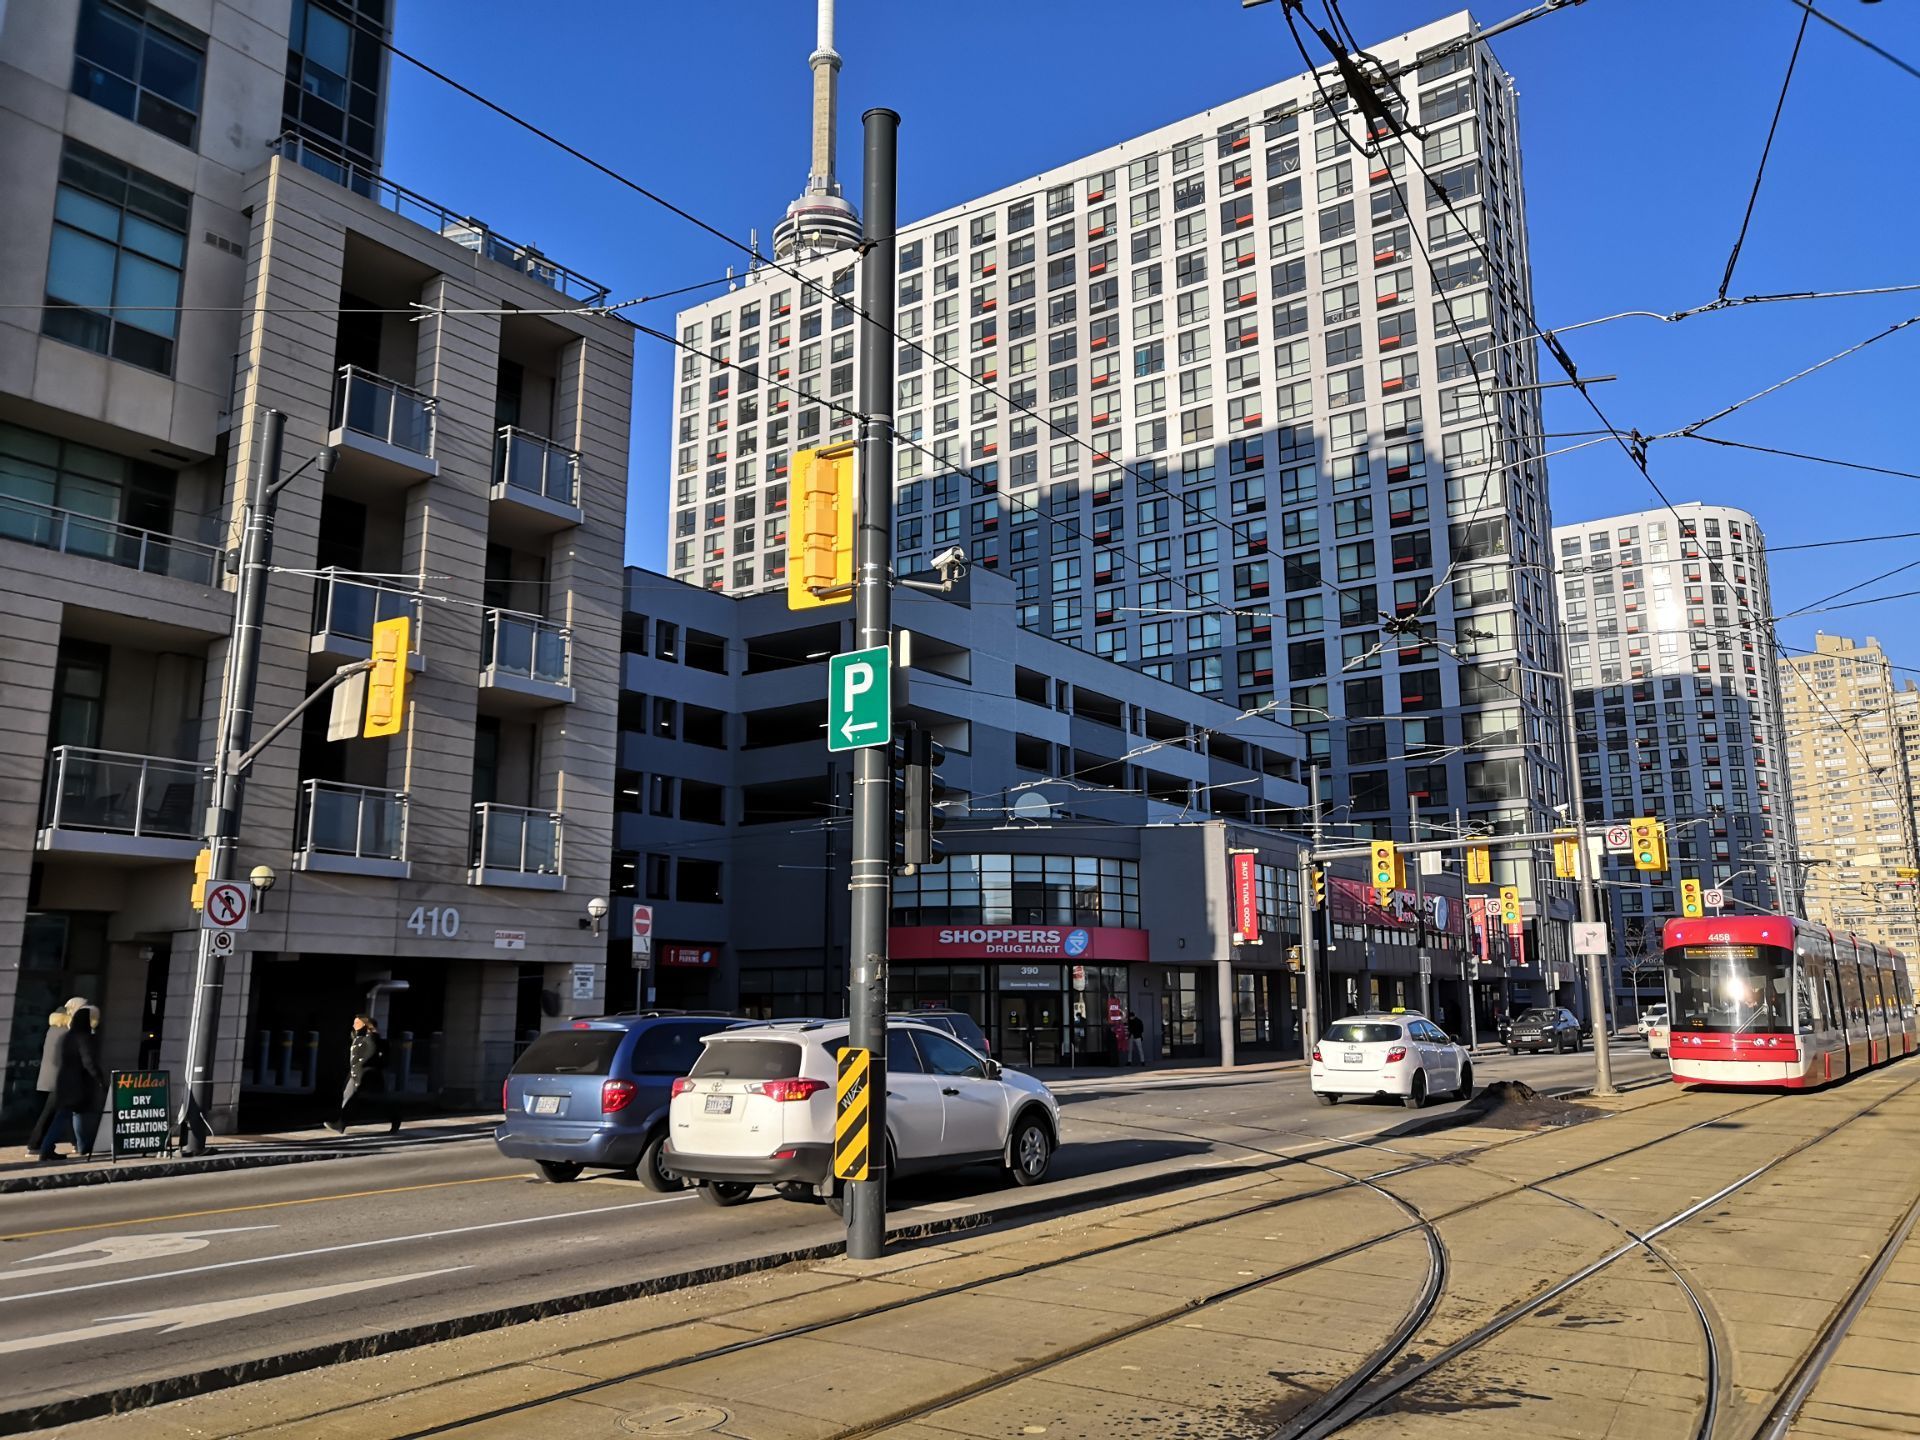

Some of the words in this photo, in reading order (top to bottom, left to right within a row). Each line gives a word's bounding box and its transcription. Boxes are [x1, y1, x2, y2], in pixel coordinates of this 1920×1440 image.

[843, 663, 873, 713] P
[407, 906, 460, 937] 410
[939, 929, 1061, 944] SHOPPERS
[1708, 933, 1730, 942] 4458
[986, 944, 1023, 953] DRUG
[1025, 945, 1061, 954] MART
[1020, 966, 1038, 975] 390
[132, 1095, 152, 1106] DRY
[118, 1108, 166, 1120] CLEANING
[115, 1121, 168, 1134] ALTERATIONS
[123, 1136, 161, 1149] REPAIRS
